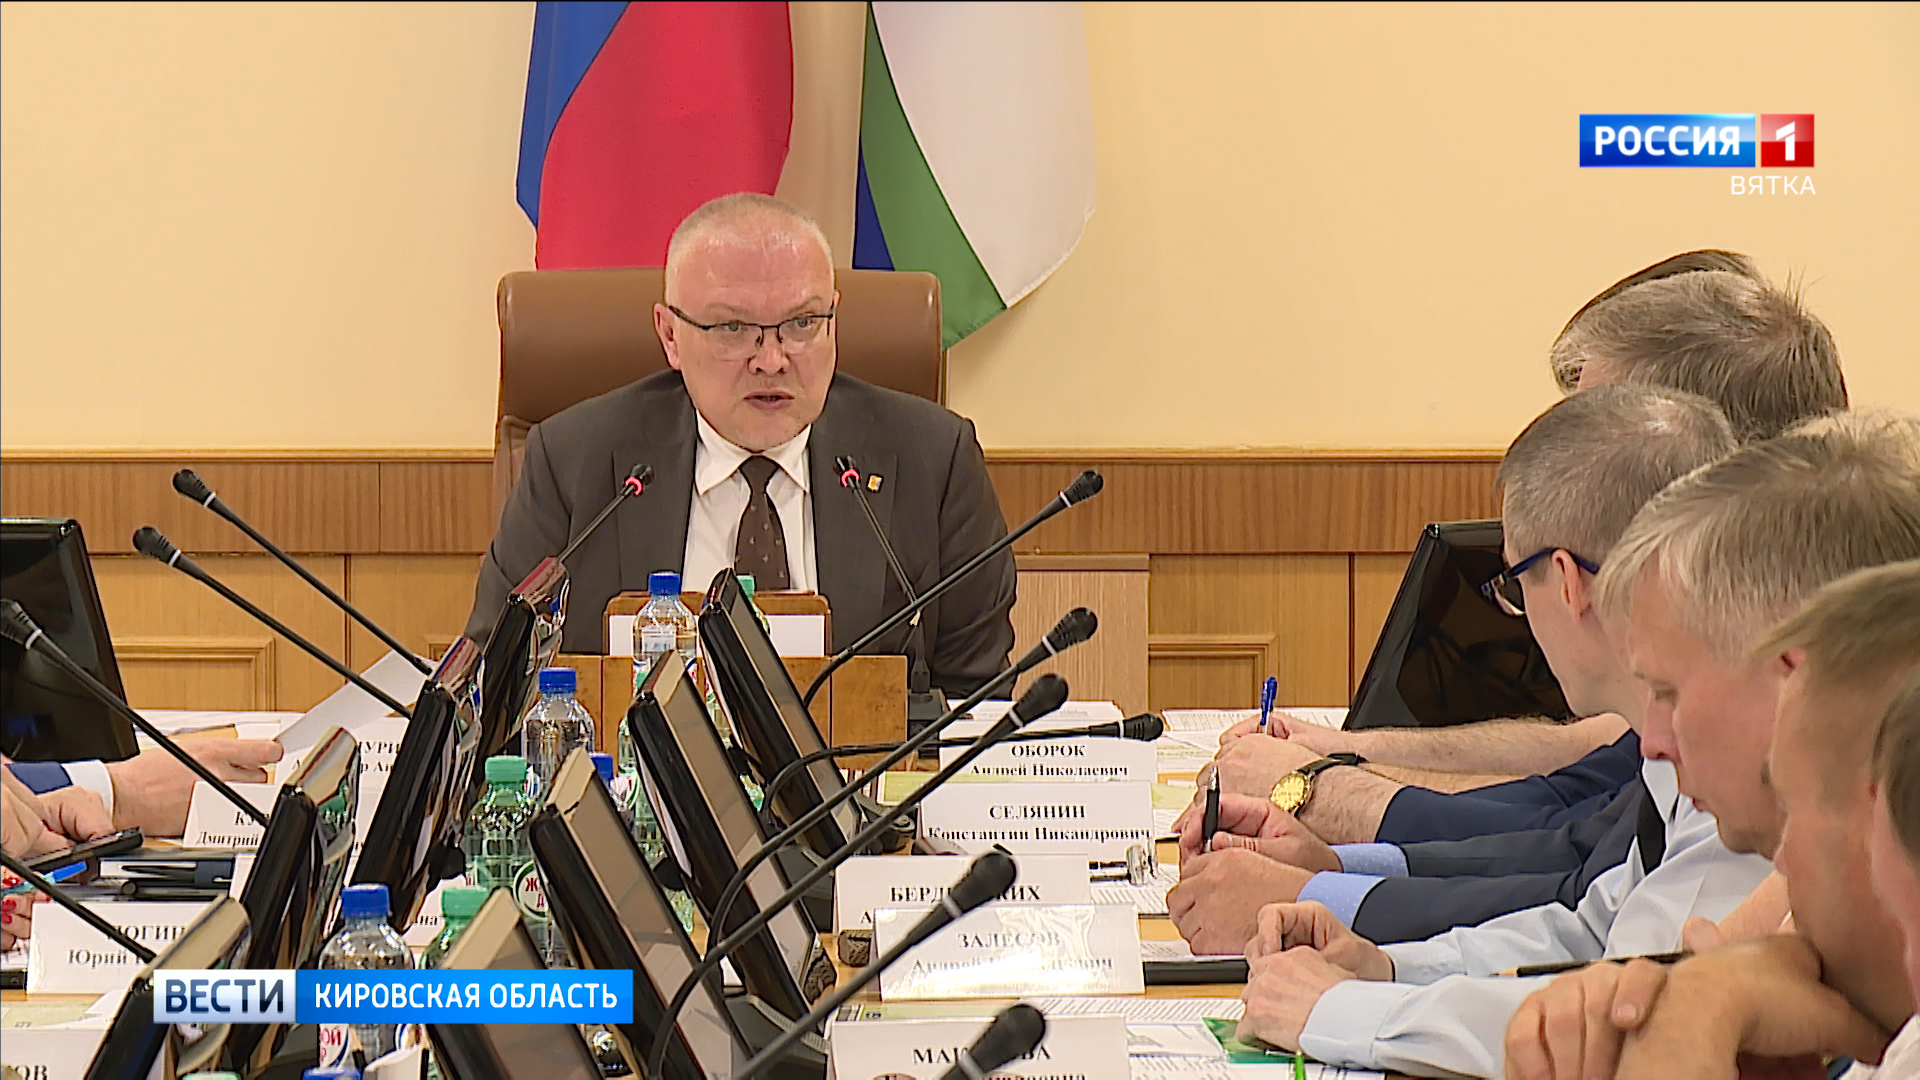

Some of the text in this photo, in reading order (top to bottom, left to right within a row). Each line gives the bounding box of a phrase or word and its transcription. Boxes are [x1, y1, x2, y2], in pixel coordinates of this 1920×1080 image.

[1011, 744, 1086, 758] ОБОРОК
[1032, 763, 1128, 777] Николаевич
[989, 804, 1086, 820] СЕЛЯНИН
[196, 831, 259, 848] Дмитрий
[928, 826, 1150, 844] Константин Никандрович
[69, 949, 128, 968] Юрий
